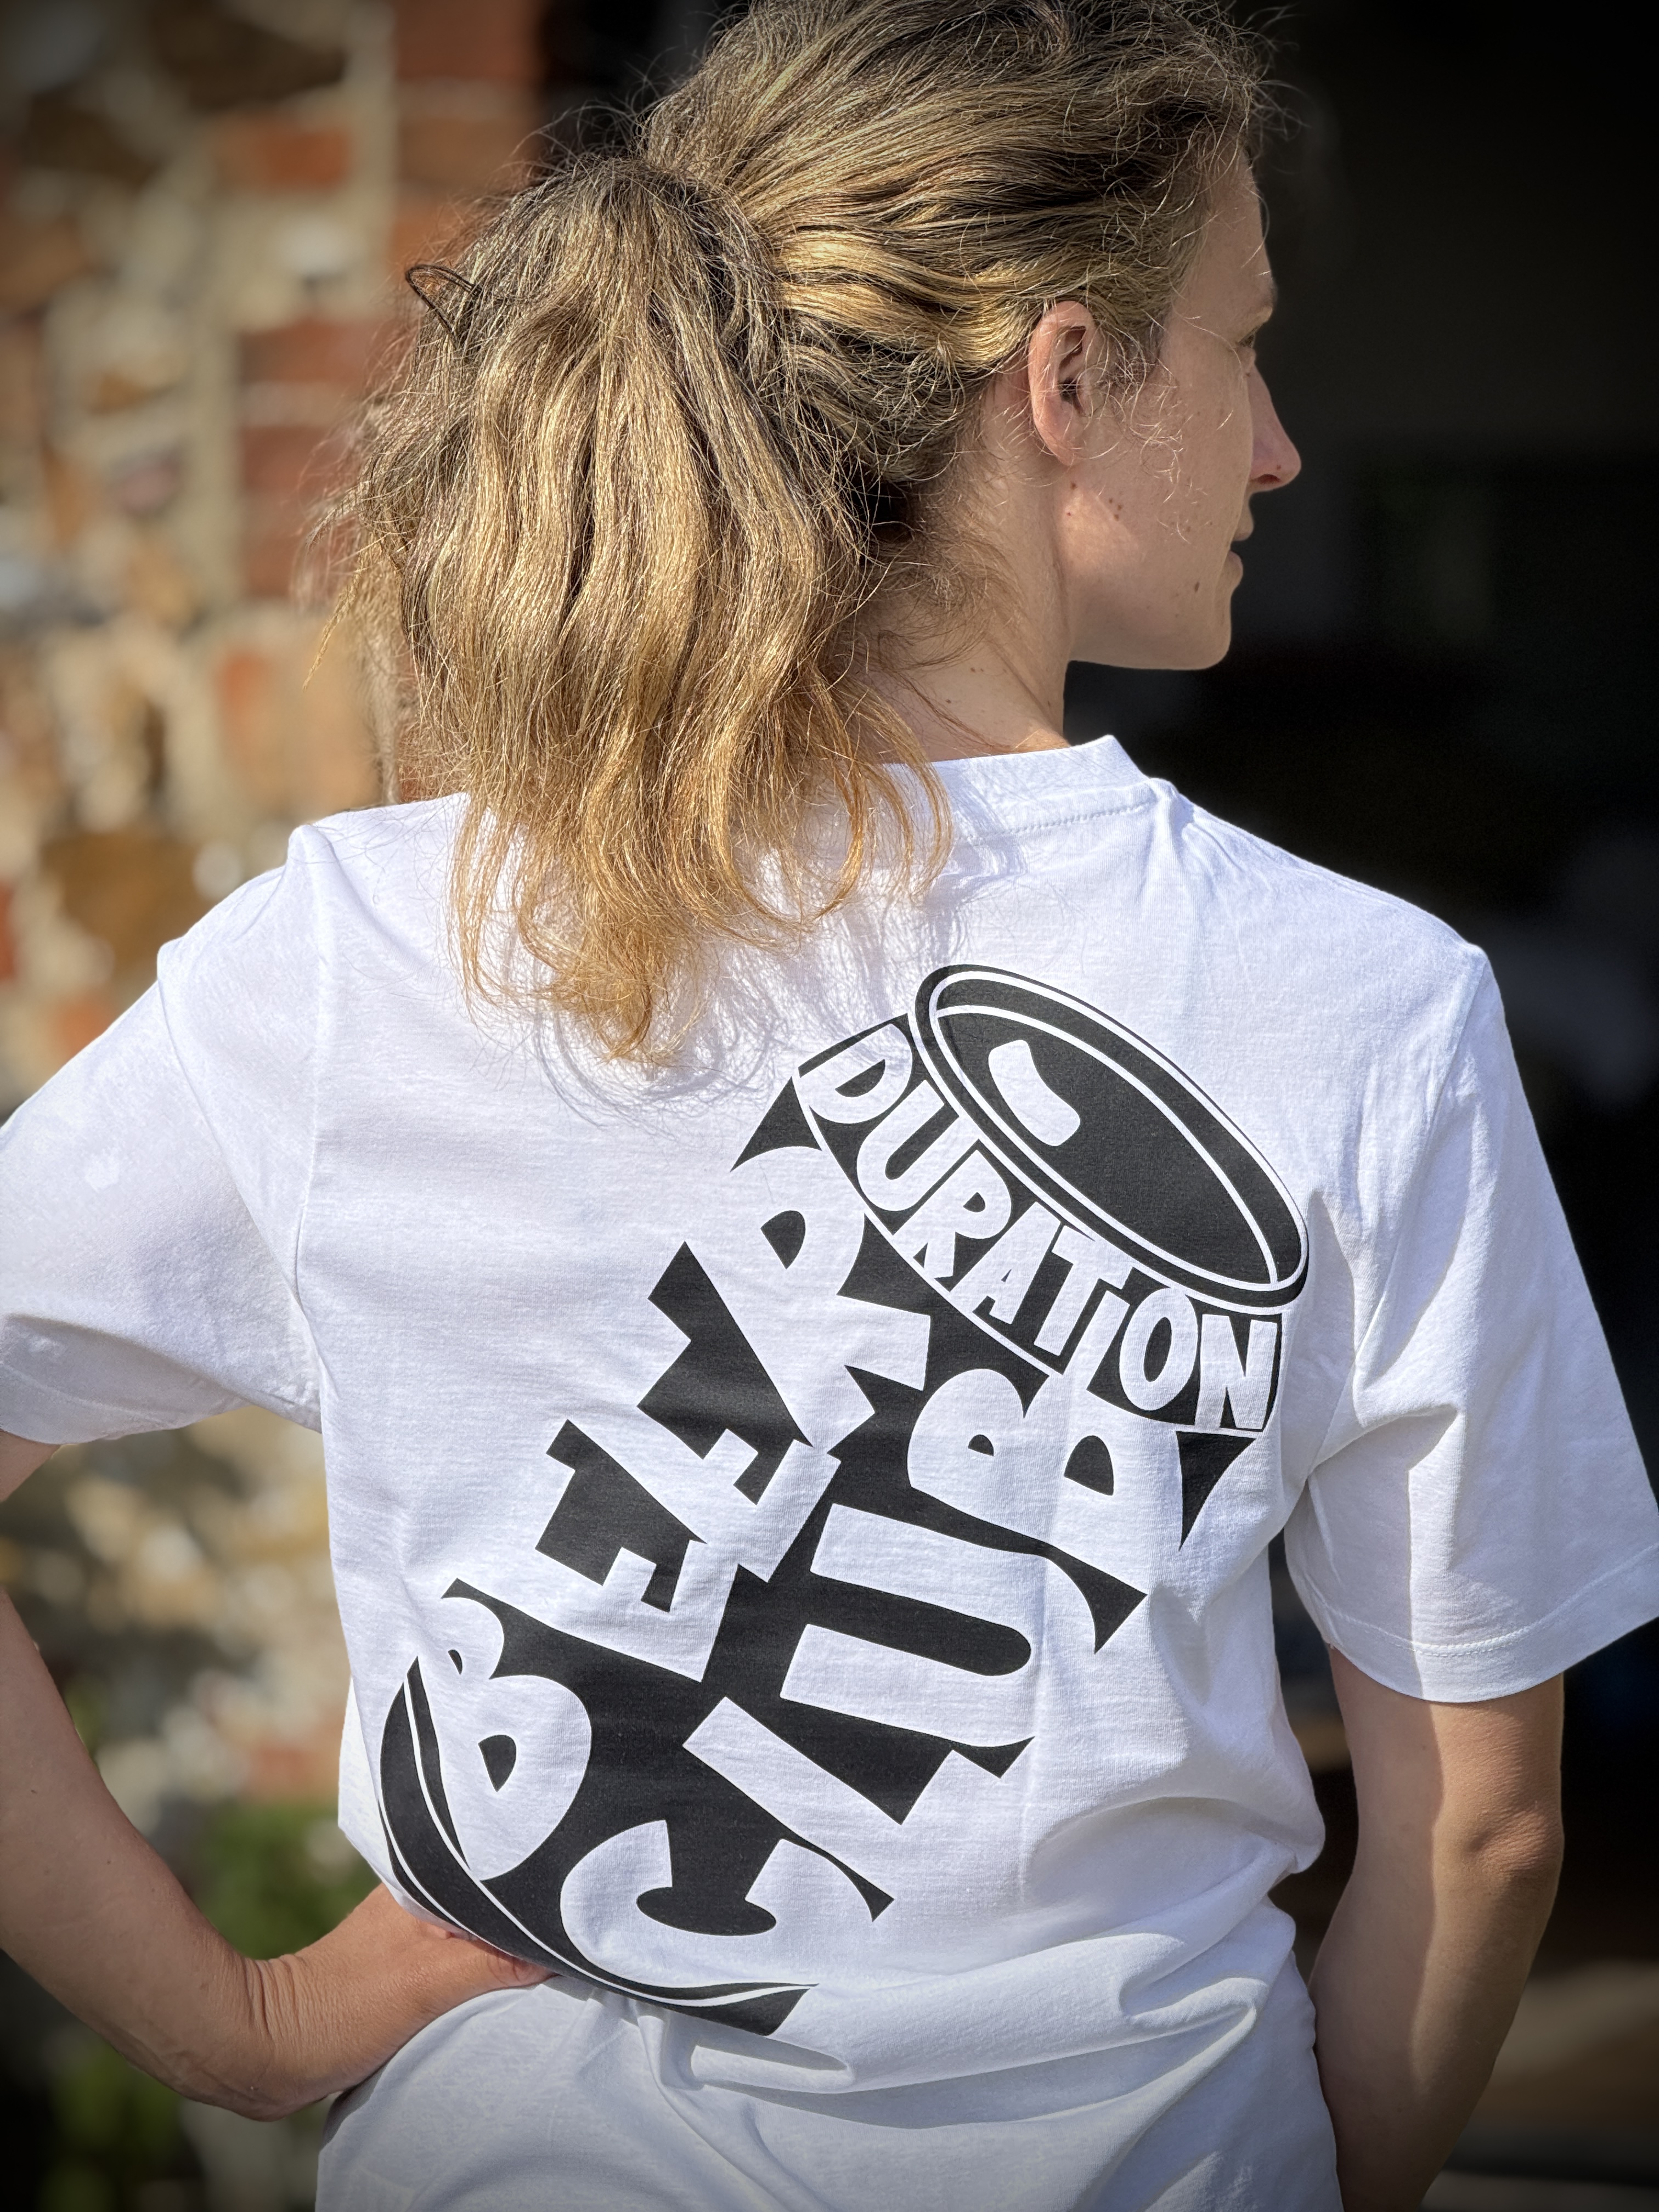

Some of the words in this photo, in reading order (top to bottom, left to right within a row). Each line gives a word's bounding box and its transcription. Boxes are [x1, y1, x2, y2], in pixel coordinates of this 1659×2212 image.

[409, 1146, 932, 1882] BEER
[795, 1024, 1278, 1430] DURATION
[560, 1367, 1183, 1984] CLUB
